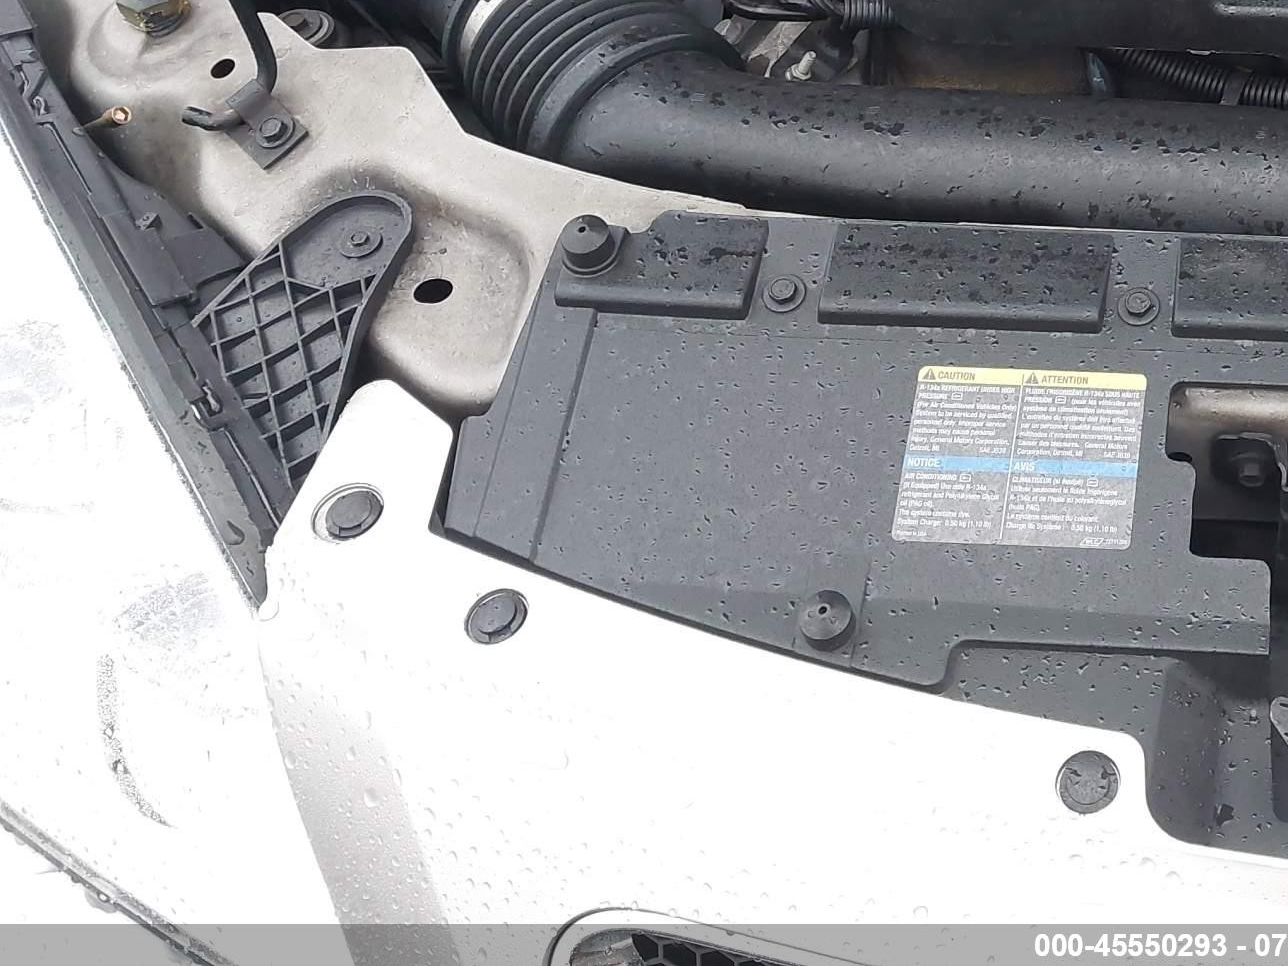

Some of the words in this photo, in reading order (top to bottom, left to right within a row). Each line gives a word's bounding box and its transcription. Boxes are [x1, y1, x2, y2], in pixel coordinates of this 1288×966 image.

[938, 371, 976, 380] CAUTION
[1041, 375, 1089, 385] ATTENTION
[907, 457, 941, 467] NOTICE
[1014, 462, 1035, 471] AVIS
